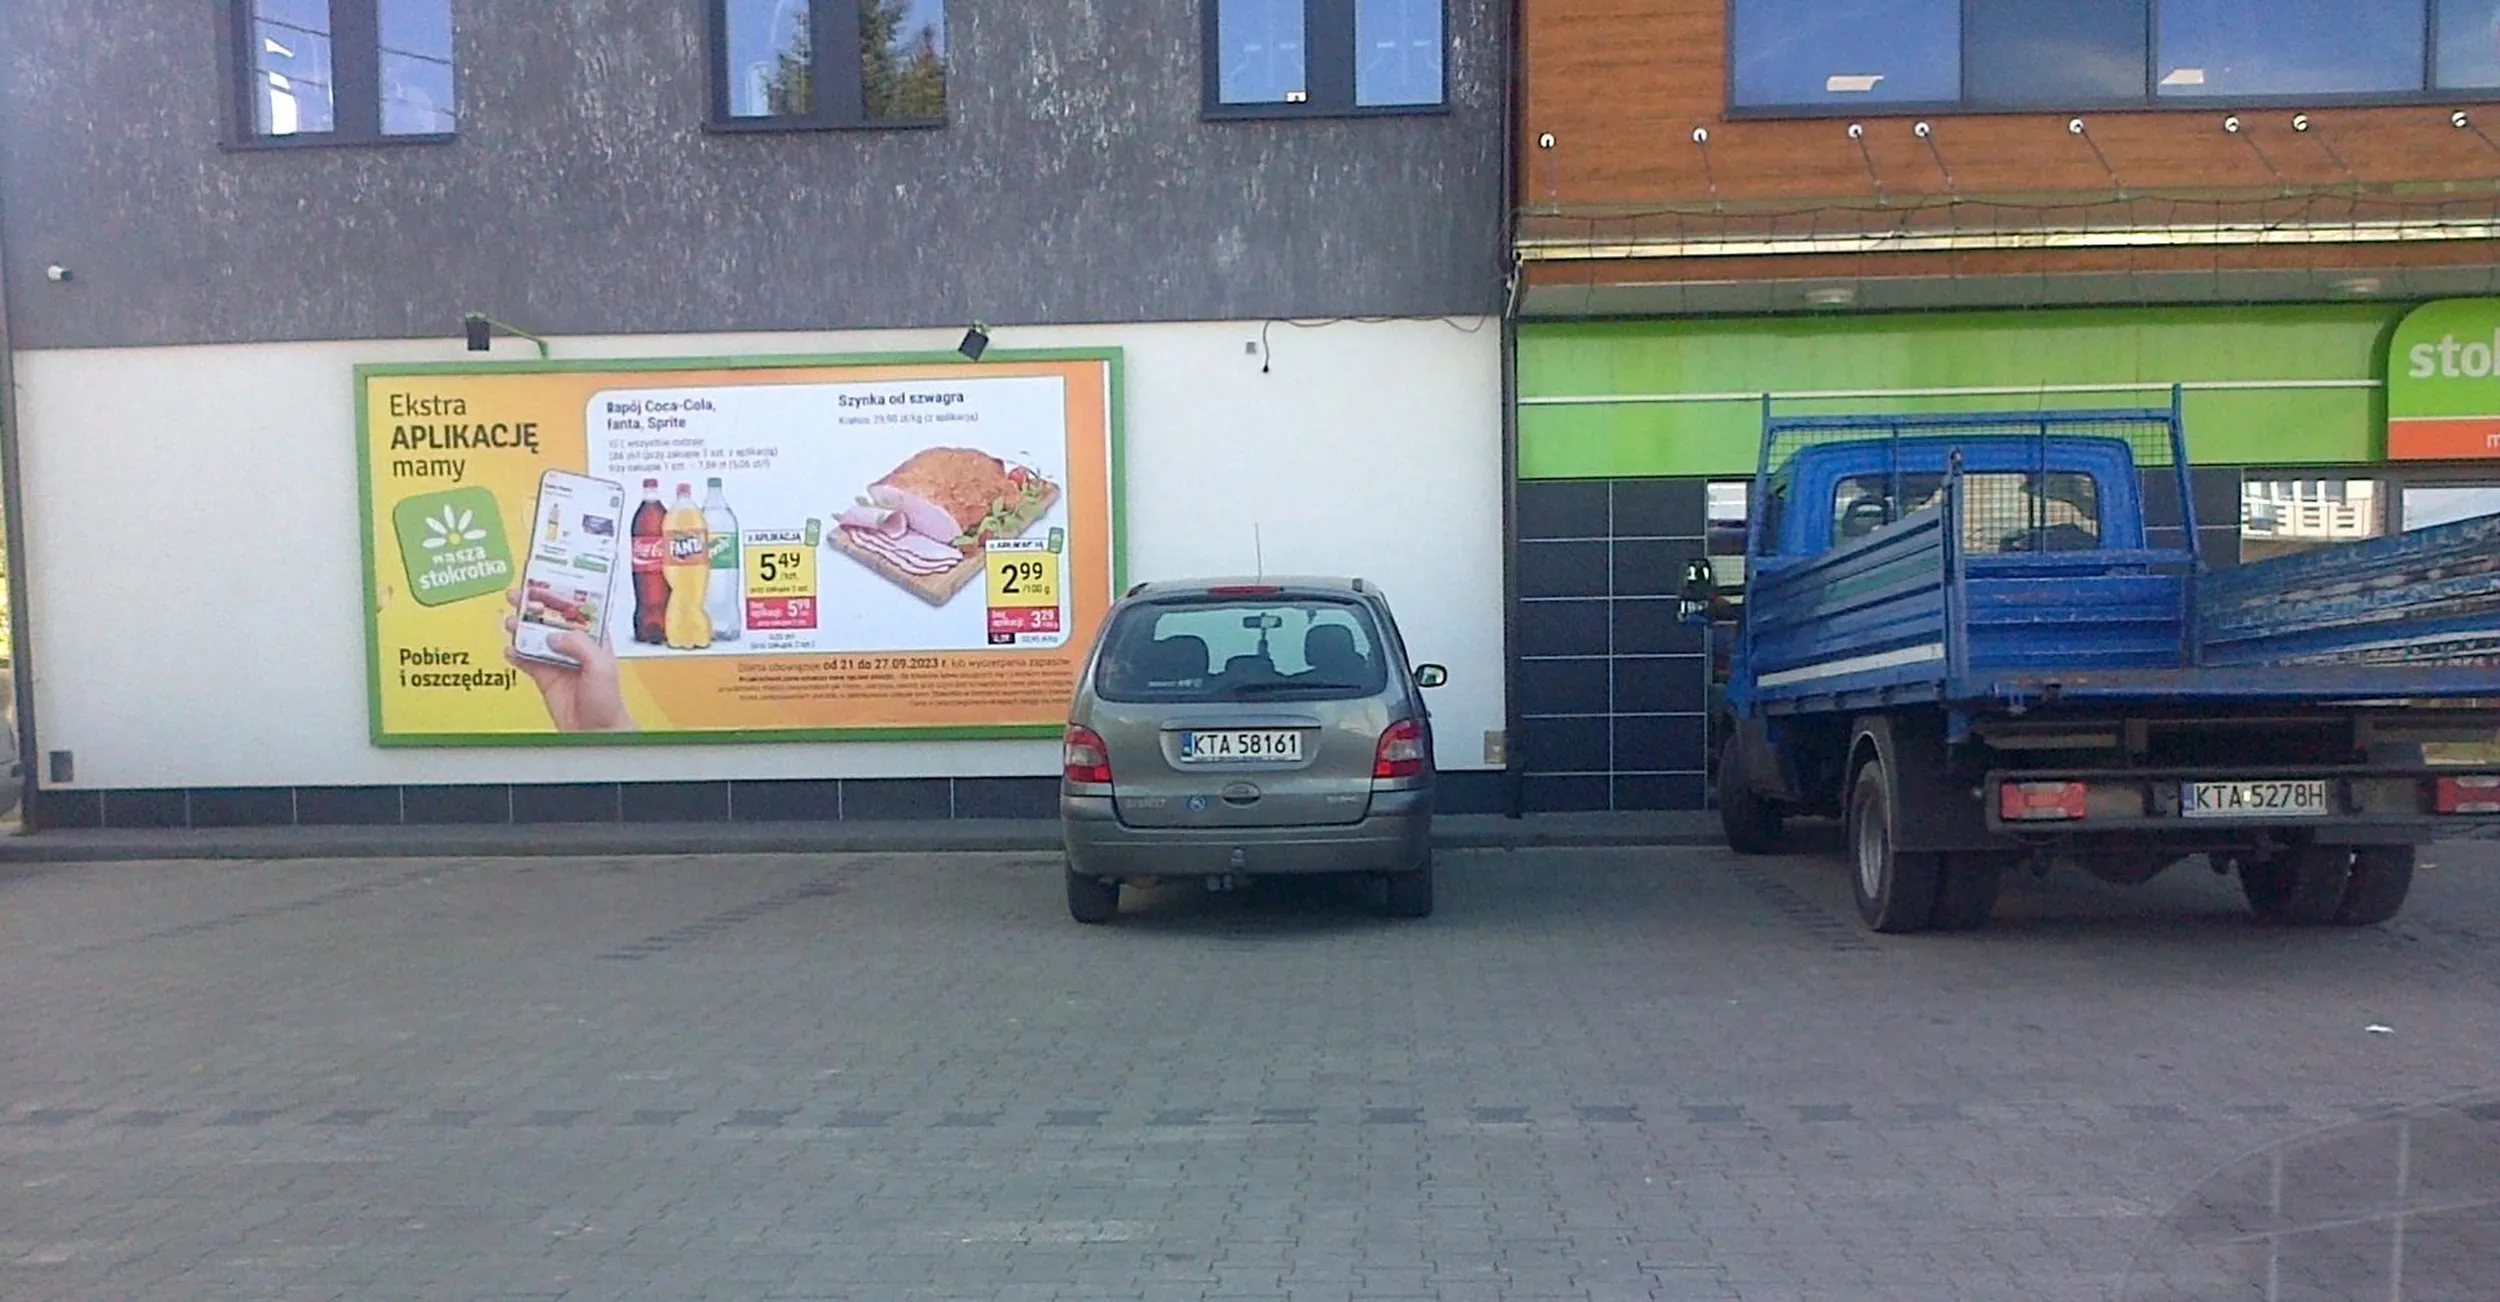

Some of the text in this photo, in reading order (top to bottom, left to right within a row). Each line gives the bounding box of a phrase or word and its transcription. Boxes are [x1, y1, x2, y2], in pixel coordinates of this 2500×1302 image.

[389, 394, 467, 417] Ekstra
[645, 397, 716, 412] Coca-Cola,
[838, 391, 965, 409] Szynka od szwagra
[647, 416, 687, 433] Sprite
[390, 422, 539, 454] APLIKACJĘ
[393, 457, 466, 482] mamy
[431, 546, 487, 564] nasza
[419, 559, 508, 590] stokrotka
[399, 647, 470, 667] Pobierz
[823, 659, 838, 671] od
[840, 658, 854, 670] 21
[857, 658, 872, 670] do
[874, 657, 938, 670] 27.09.2023
[400, 668, 517, 691] i oszczędzaj!
[1193, 733, 1296, 755] KTA 58161
[2195, 783, 2324, 808] KTA 5278H
